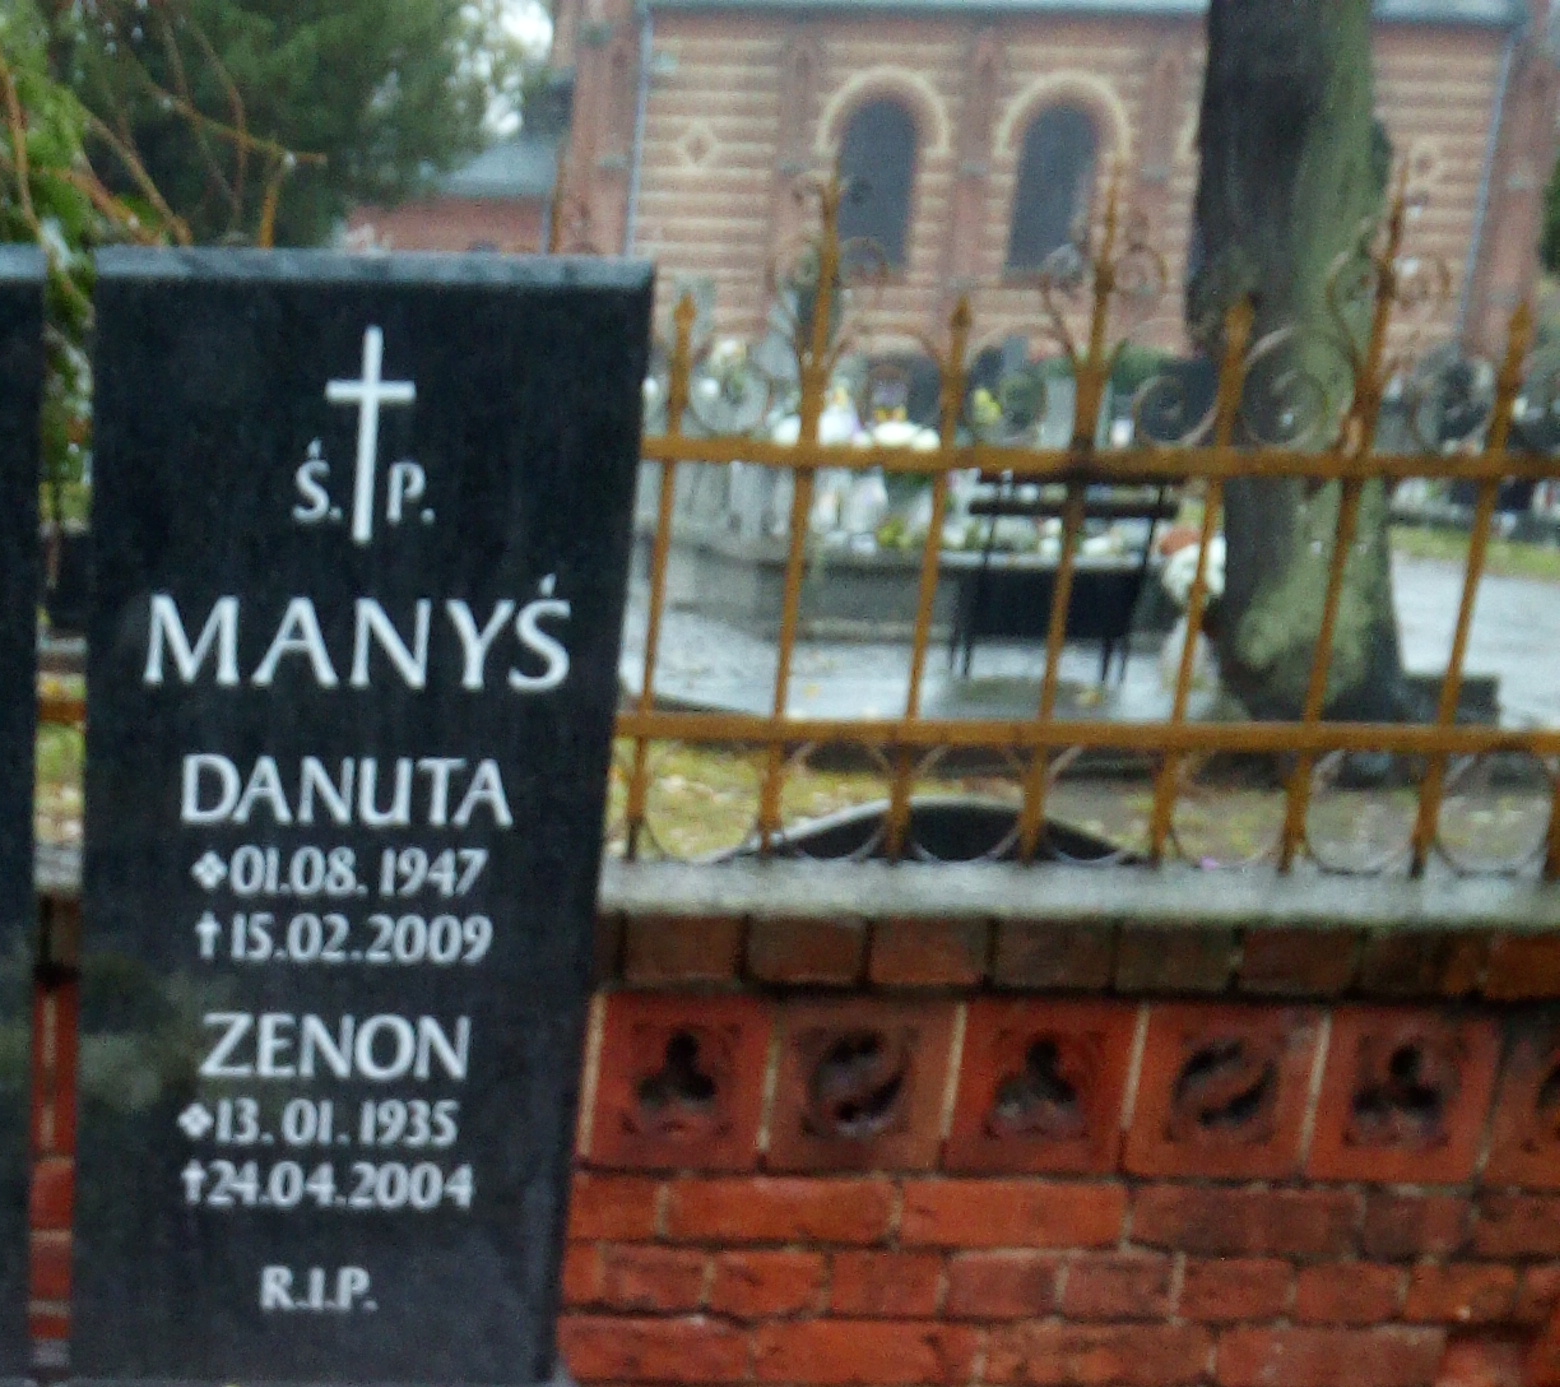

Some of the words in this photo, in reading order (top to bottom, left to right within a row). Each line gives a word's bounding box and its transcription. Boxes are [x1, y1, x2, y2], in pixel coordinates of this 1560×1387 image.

[292, 439, 342, 524] Ś.
[385, 460, 435, 524] P.
[142, 573, 572, 693] MANYŚ
[179, 753, 513, 829] DANUTA
[229, 911, 494, 965] 15.02.2009
[197, 1011, 472, 1082] ZENON
[206, 1159, 475, 1210] 24.04.2004
[258, 1264, 379, 1313] R.I.P.
